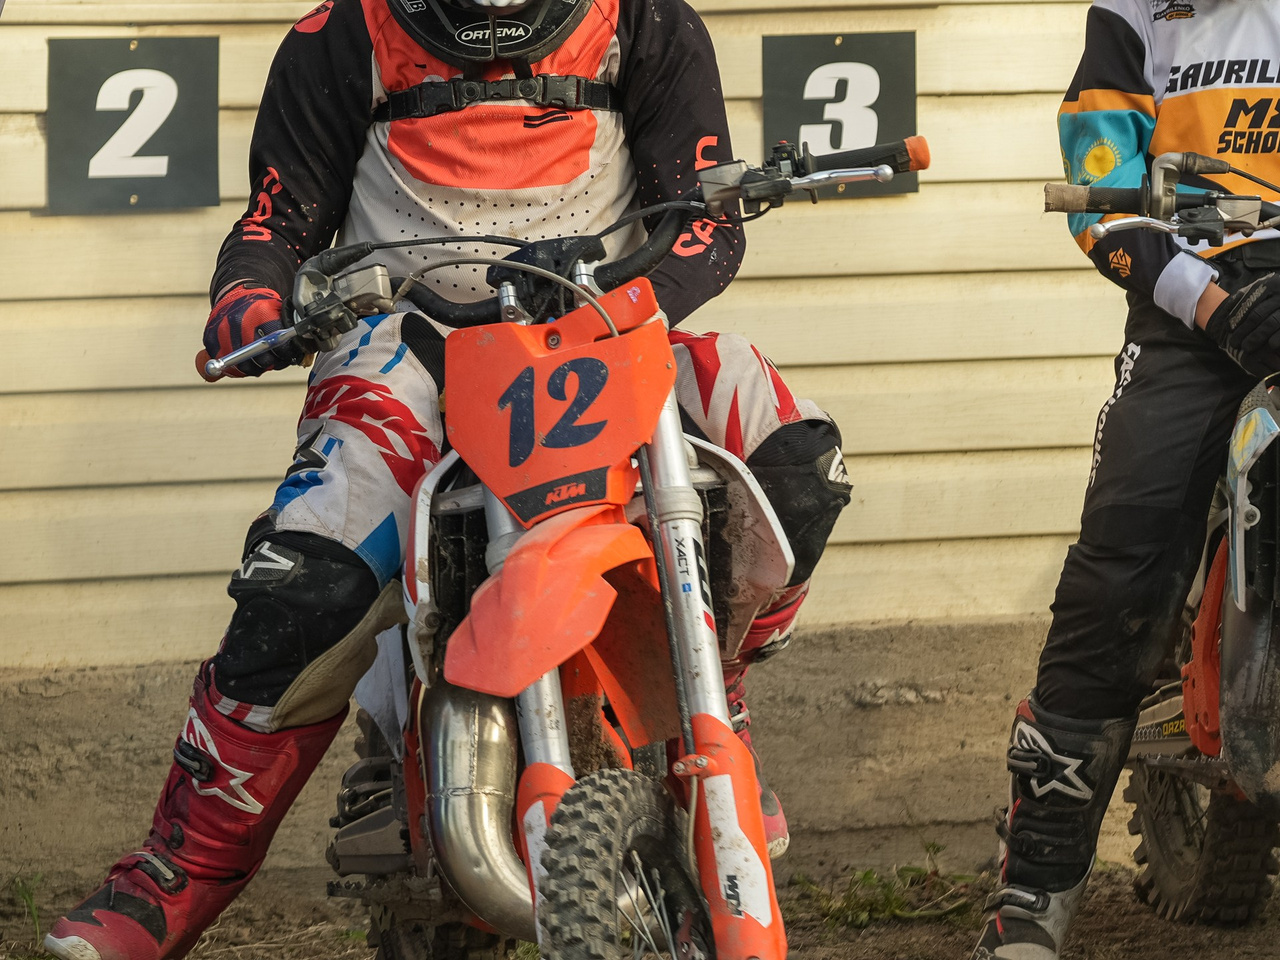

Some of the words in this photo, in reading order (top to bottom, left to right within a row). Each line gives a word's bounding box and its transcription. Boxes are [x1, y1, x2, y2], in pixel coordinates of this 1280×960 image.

[461, 26, 526, 41] ORTEMA
[88, 69, 179, 179] 2
[799, 61, 880, 156] 3
[497, 357, 609, 468] 12
[545, 482, 586, 505] KTM
[673, 537, 690, 577] XACT
